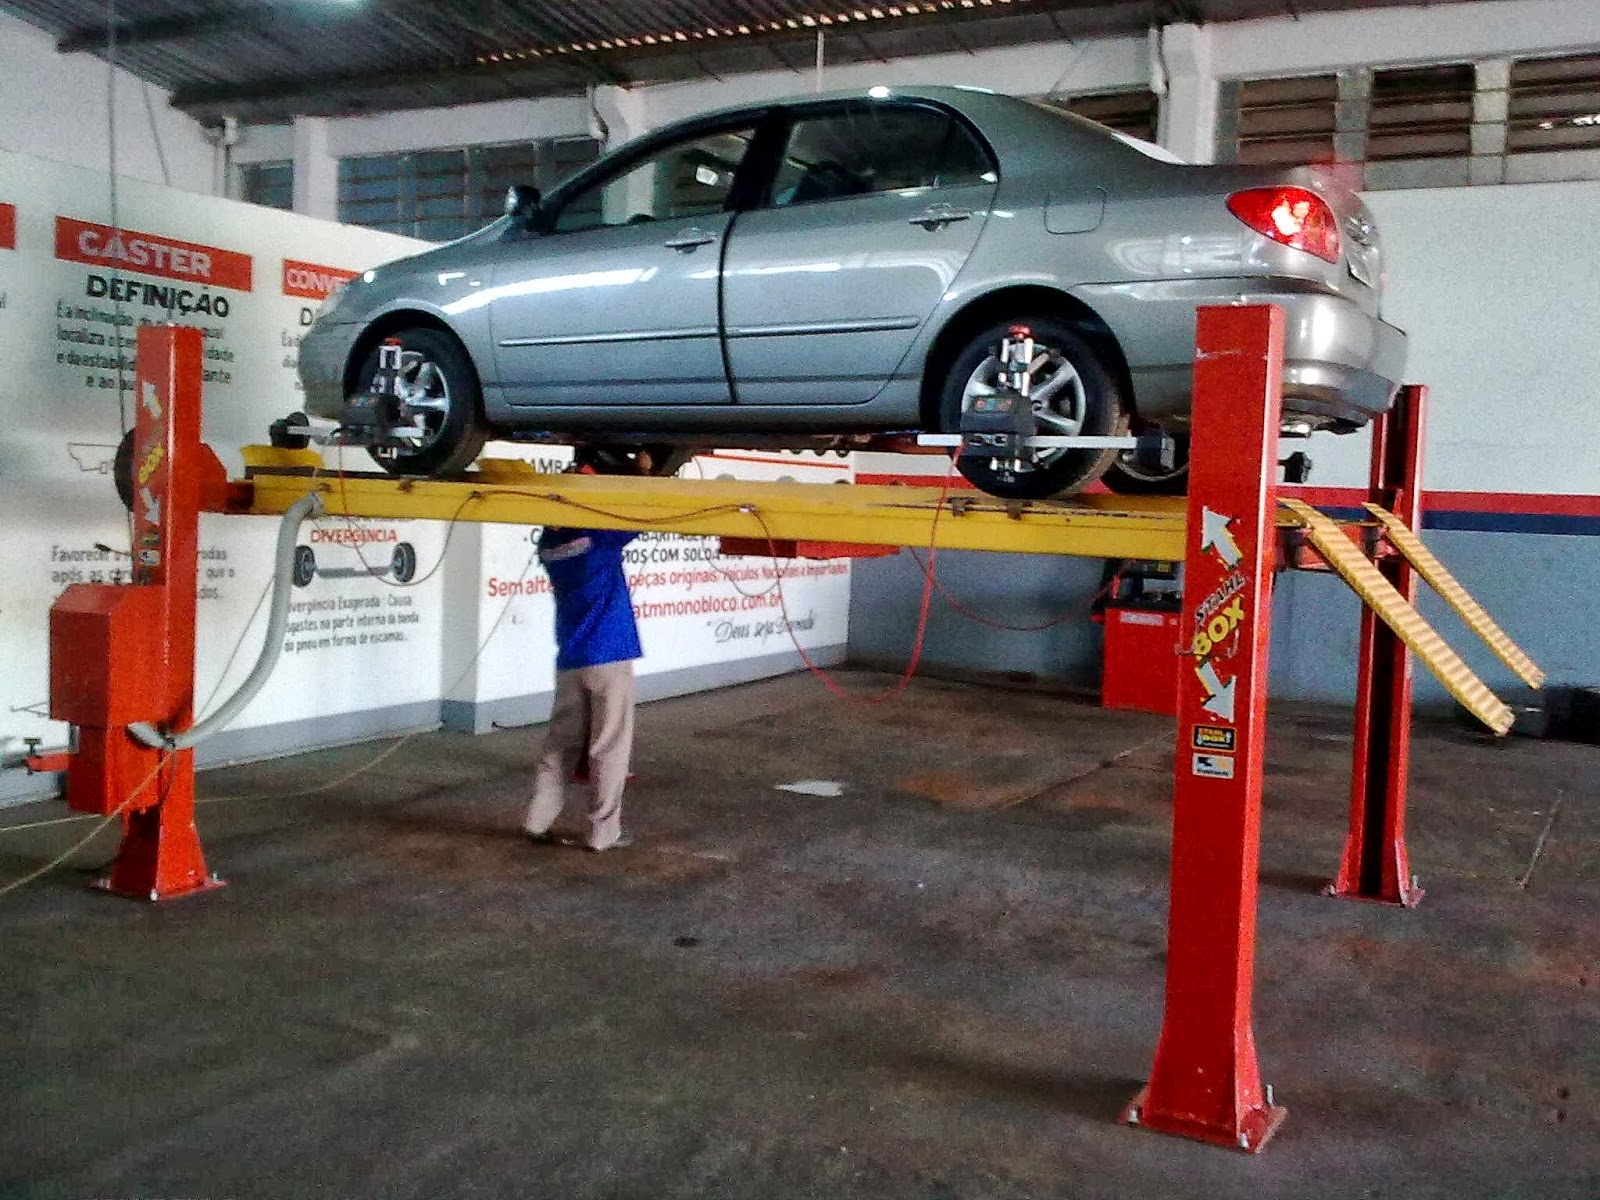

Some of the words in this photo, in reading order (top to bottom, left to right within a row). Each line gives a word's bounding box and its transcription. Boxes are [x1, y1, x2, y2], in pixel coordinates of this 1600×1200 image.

[86, 274, 229, 318] DEFINIÇÃO
[651, 547, 679, 563] COM
[487, 577, 523, 598] Sem
[525, 574, 554, 596] alte
[633, 590, 782, 619] atmmonobloco.com.br
[1192, 596, 1246, 656] BOX
